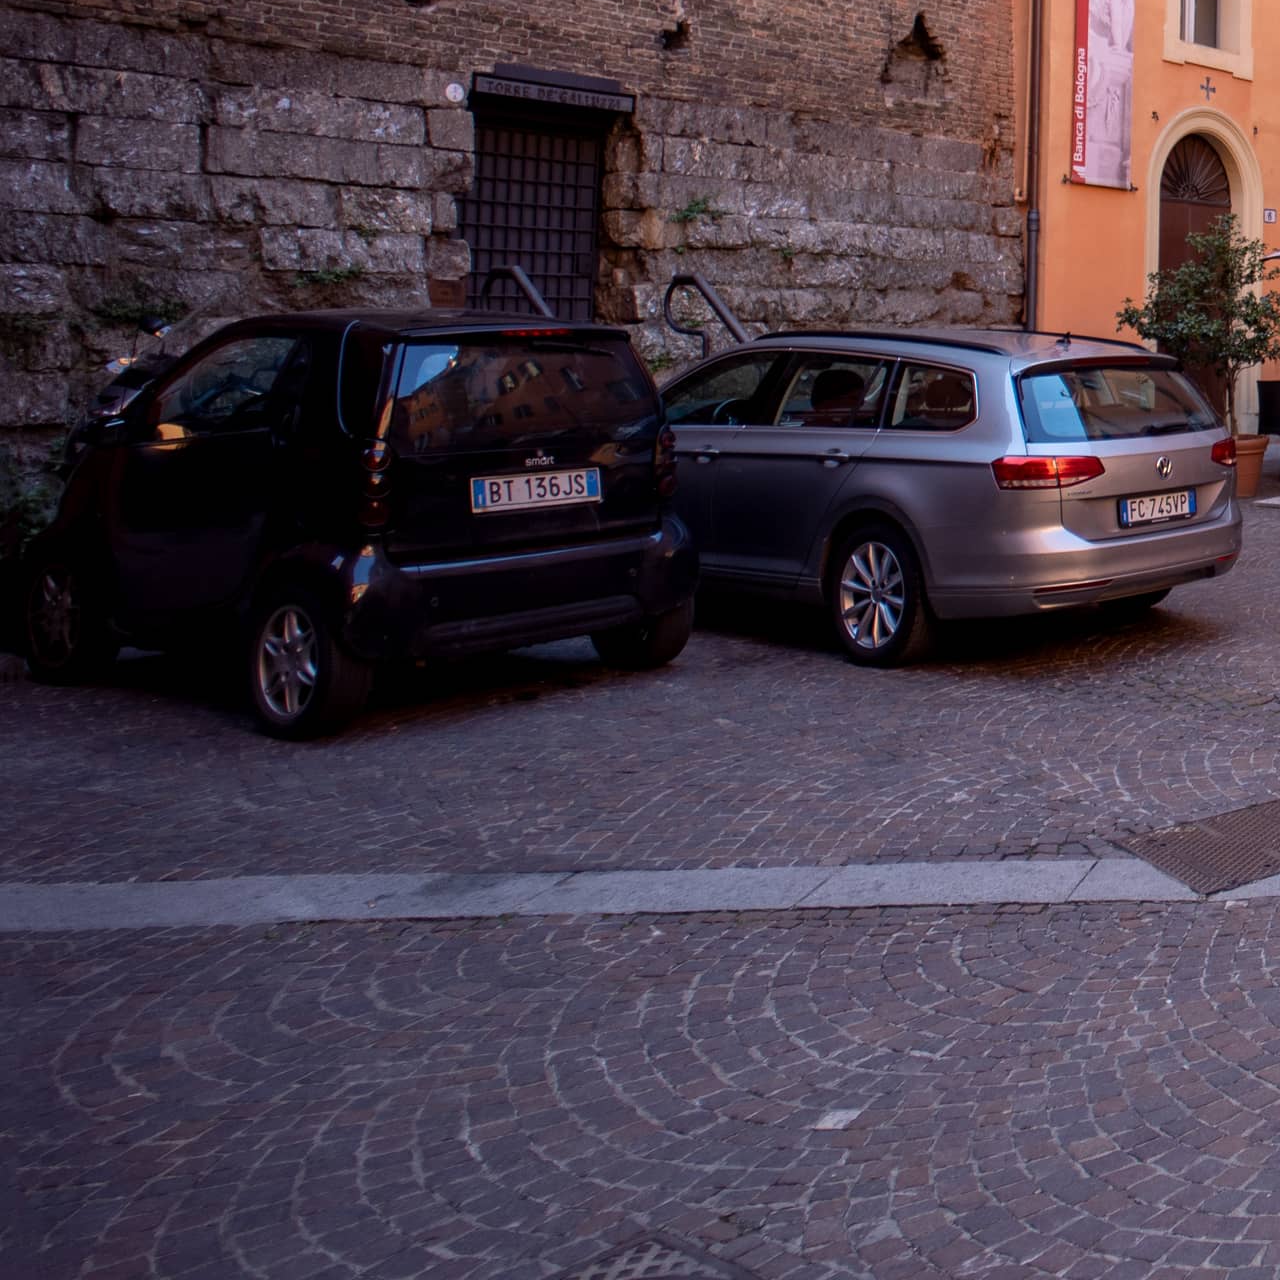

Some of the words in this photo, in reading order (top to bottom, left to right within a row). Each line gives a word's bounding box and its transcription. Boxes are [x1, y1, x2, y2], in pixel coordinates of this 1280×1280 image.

[1075, 47, 1087, 102] Bologna
[486, 80, 530, 99] TORRE
[1075, 106, 1084, 119] di
[1073, 122, 1084, 161] Banca
[525, 456, 555, 467] smart
[489, 480, 514, 504] BT
[525, 474, 586, 500] 136JS
[1129, 500, 1146, 519] FC
[1149, 494, 1187, 518] 745VP
